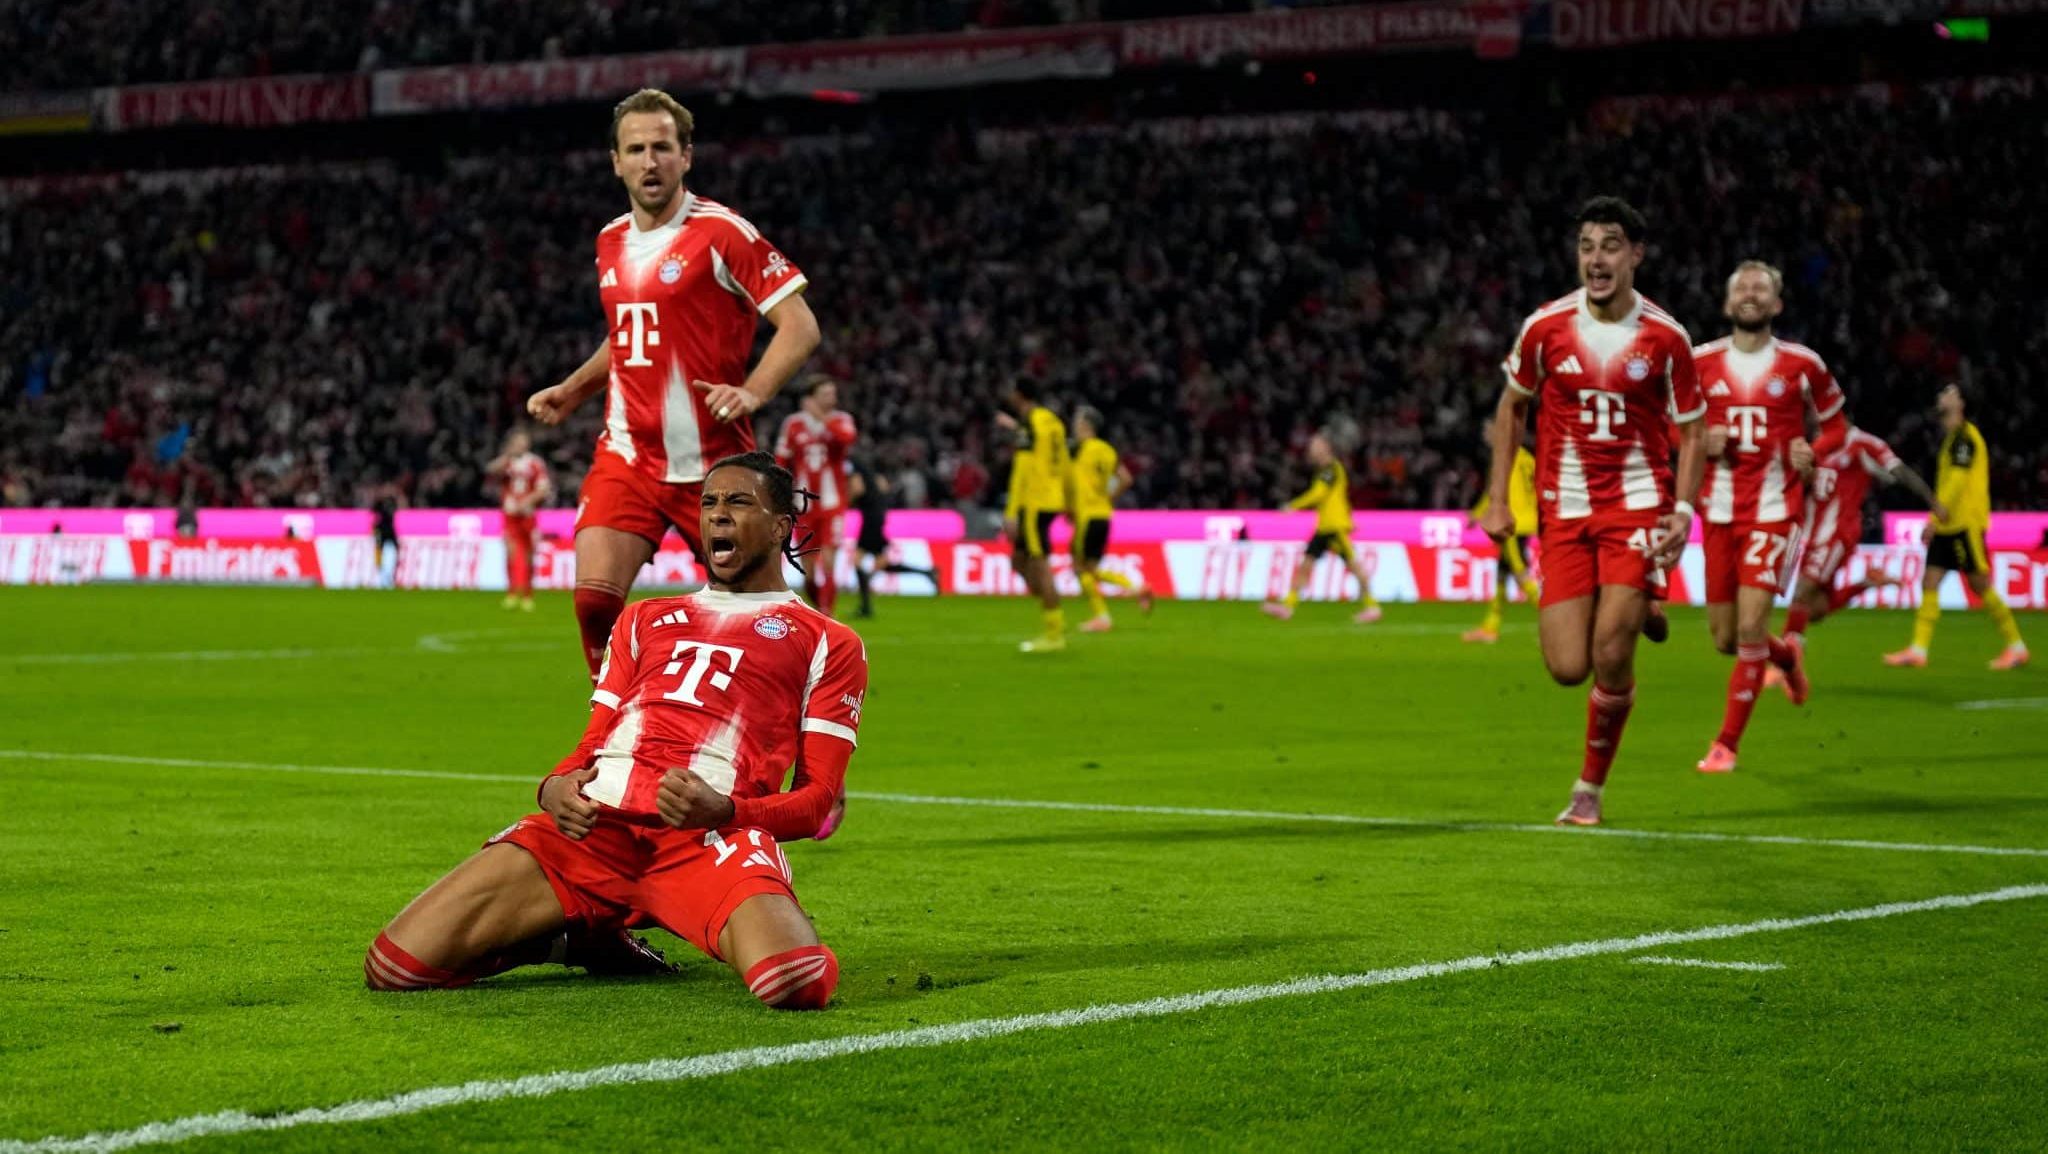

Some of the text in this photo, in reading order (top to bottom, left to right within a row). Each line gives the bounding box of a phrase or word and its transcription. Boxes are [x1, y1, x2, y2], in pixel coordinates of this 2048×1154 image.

[1551, 0, 1800, 48] DILLINGEN
[616, 302, 660, 367] T
[1578, 388, 1627, 441] T
[1726, 406, 1768, 452] T
[149, 538, 300, 581] Emirates
[1744, 530, 1787, 567] 27
[663, 640, 744, 707] T
